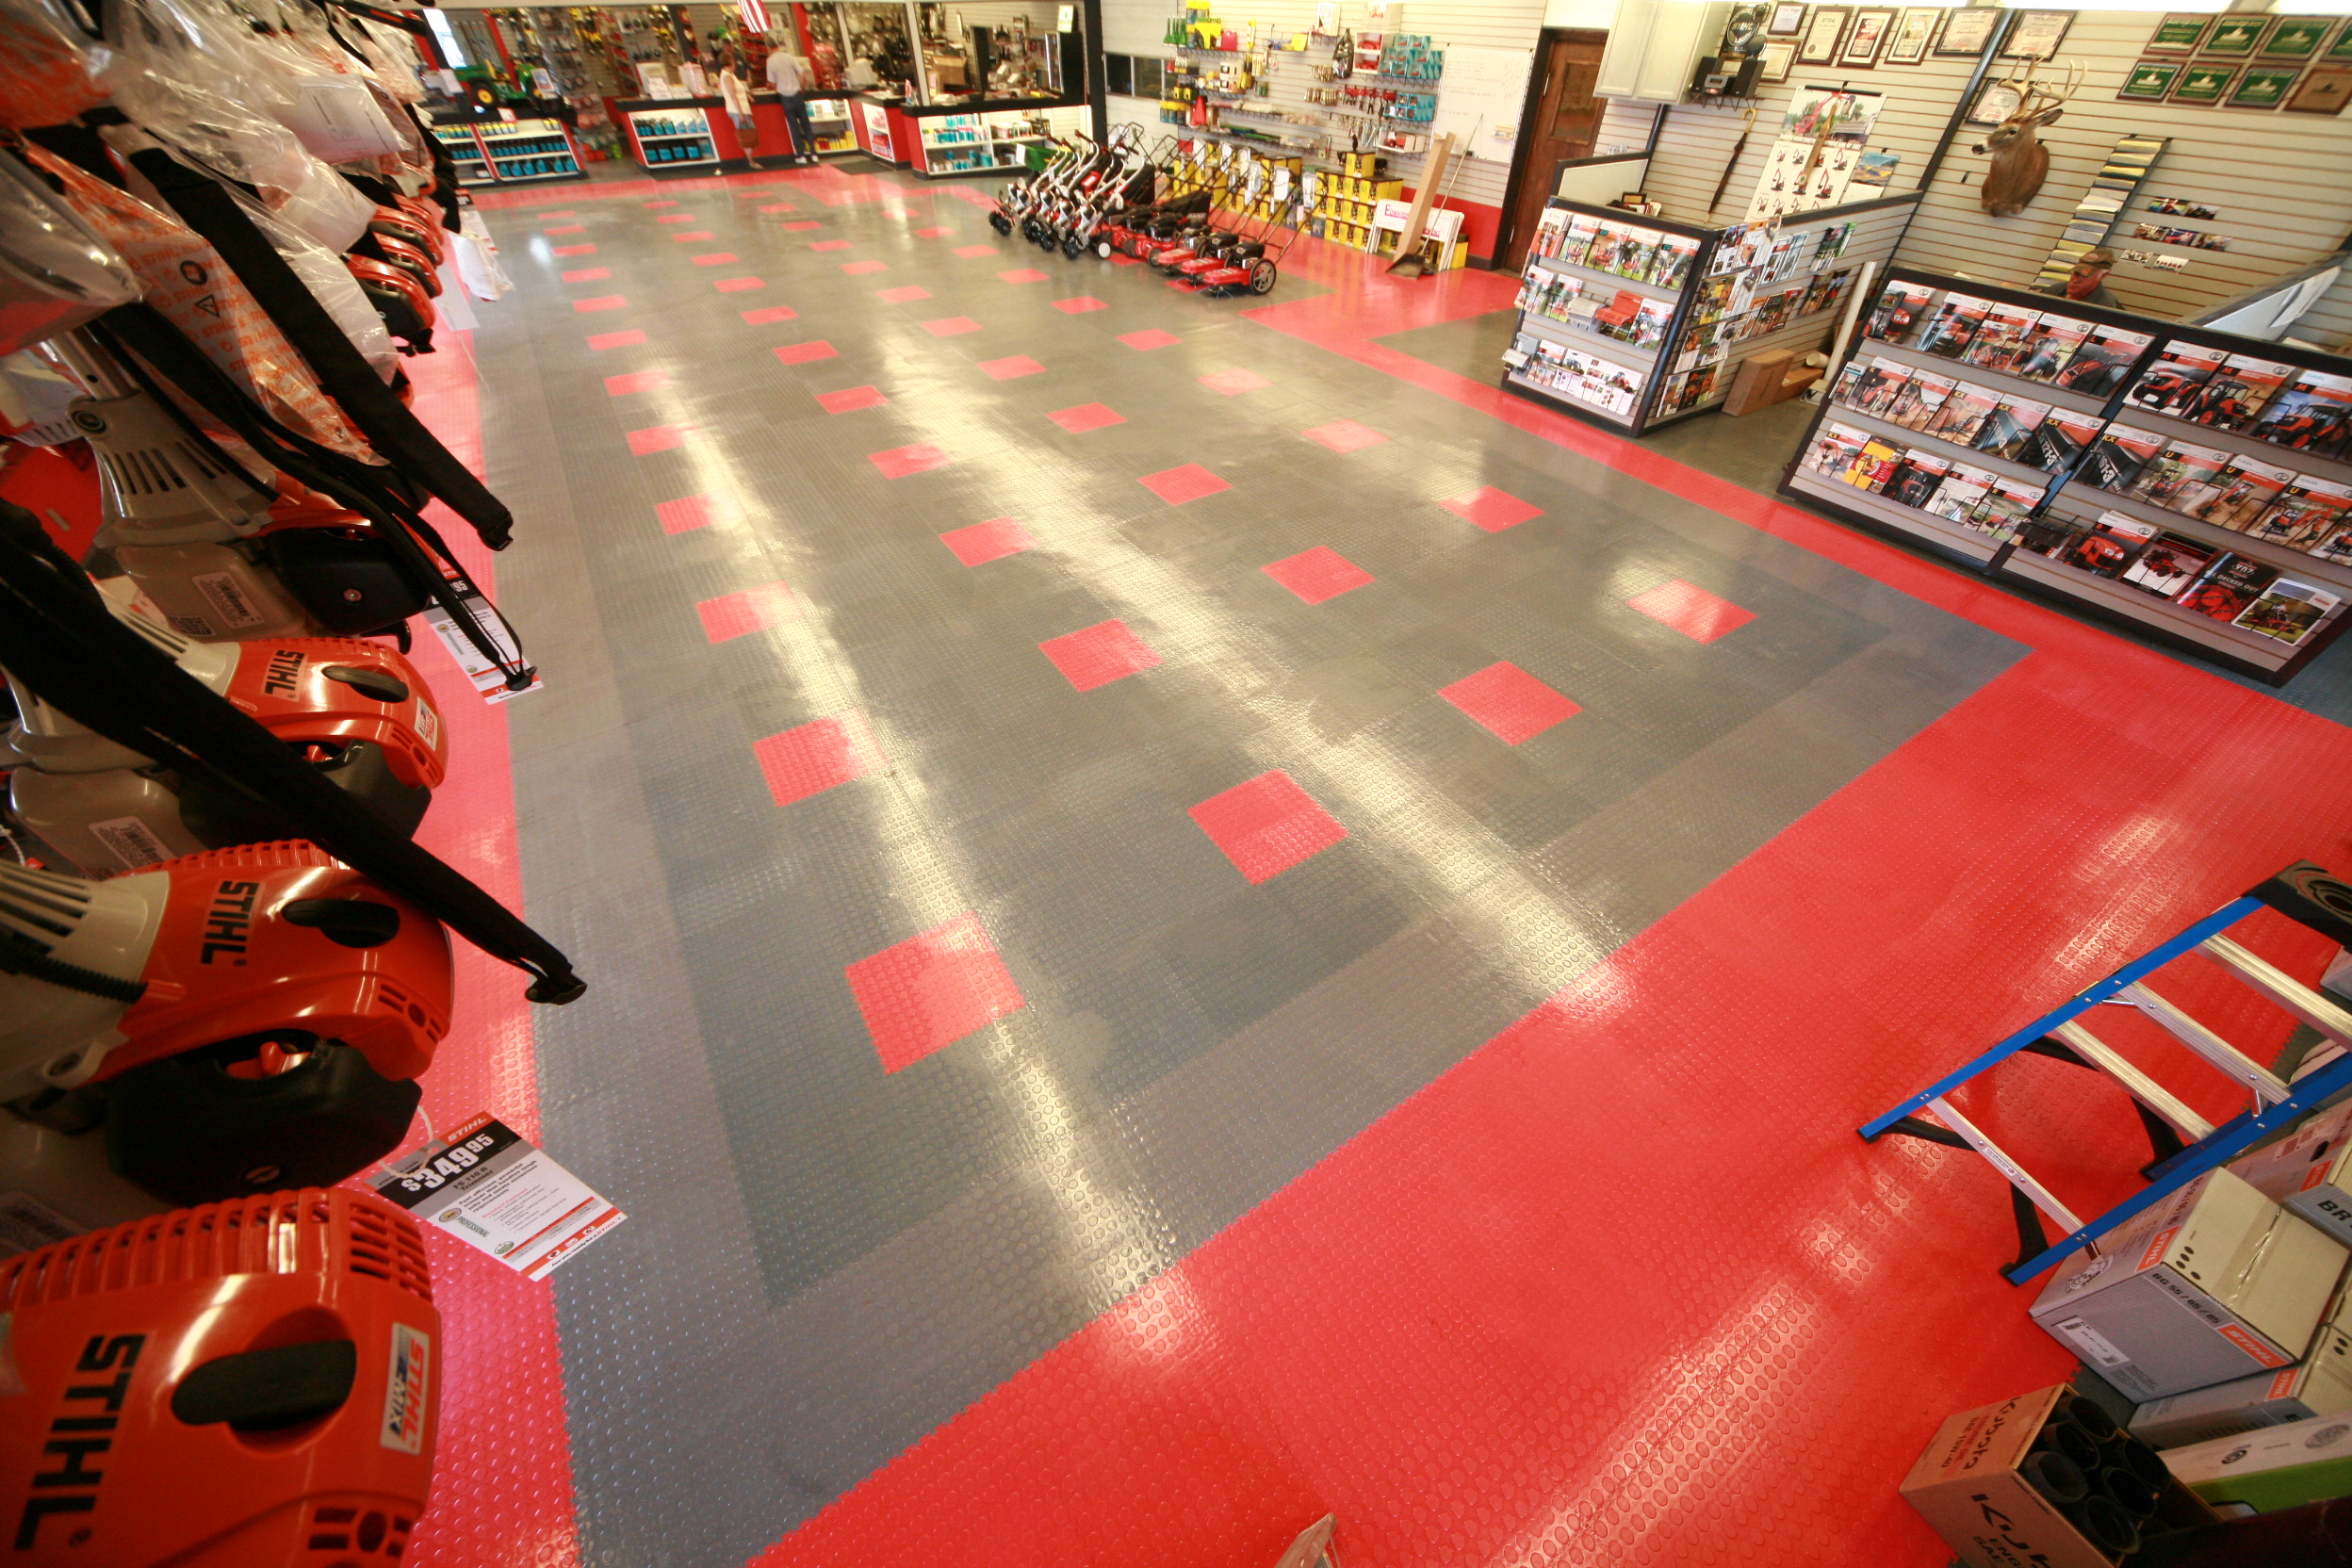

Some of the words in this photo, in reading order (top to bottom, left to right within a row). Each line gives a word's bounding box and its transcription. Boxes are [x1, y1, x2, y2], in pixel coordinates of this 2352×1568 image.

[1998, 403, 2011, 412] KX
[2047, 417, 2061, 427] KX
[2101, 434, 2116, 443] KX
[264, 649, 304, 695] STIHL
[200, 880, 259, 964] STIHL
[447, 1116, 487, 1143] STIHL
[2316, 1200, 2352, 1221] BR
[2144, 1231, 2169, 1265] STIHL
[2151, 1272, 2168, 1286] BG
[2168, 1283, 2182, 1296] 55
[2187, 1298, 2201, 1311] 65
[2227, 1329, 2273, 1363] STIHL
[400, 1336, 425, 1442] STIHL
[2274, 1372, 2291, 1396] STIHL
[13, 1333, 146, 1551] STIHL
[1964, 1396, 2021, 1470] Kubota
